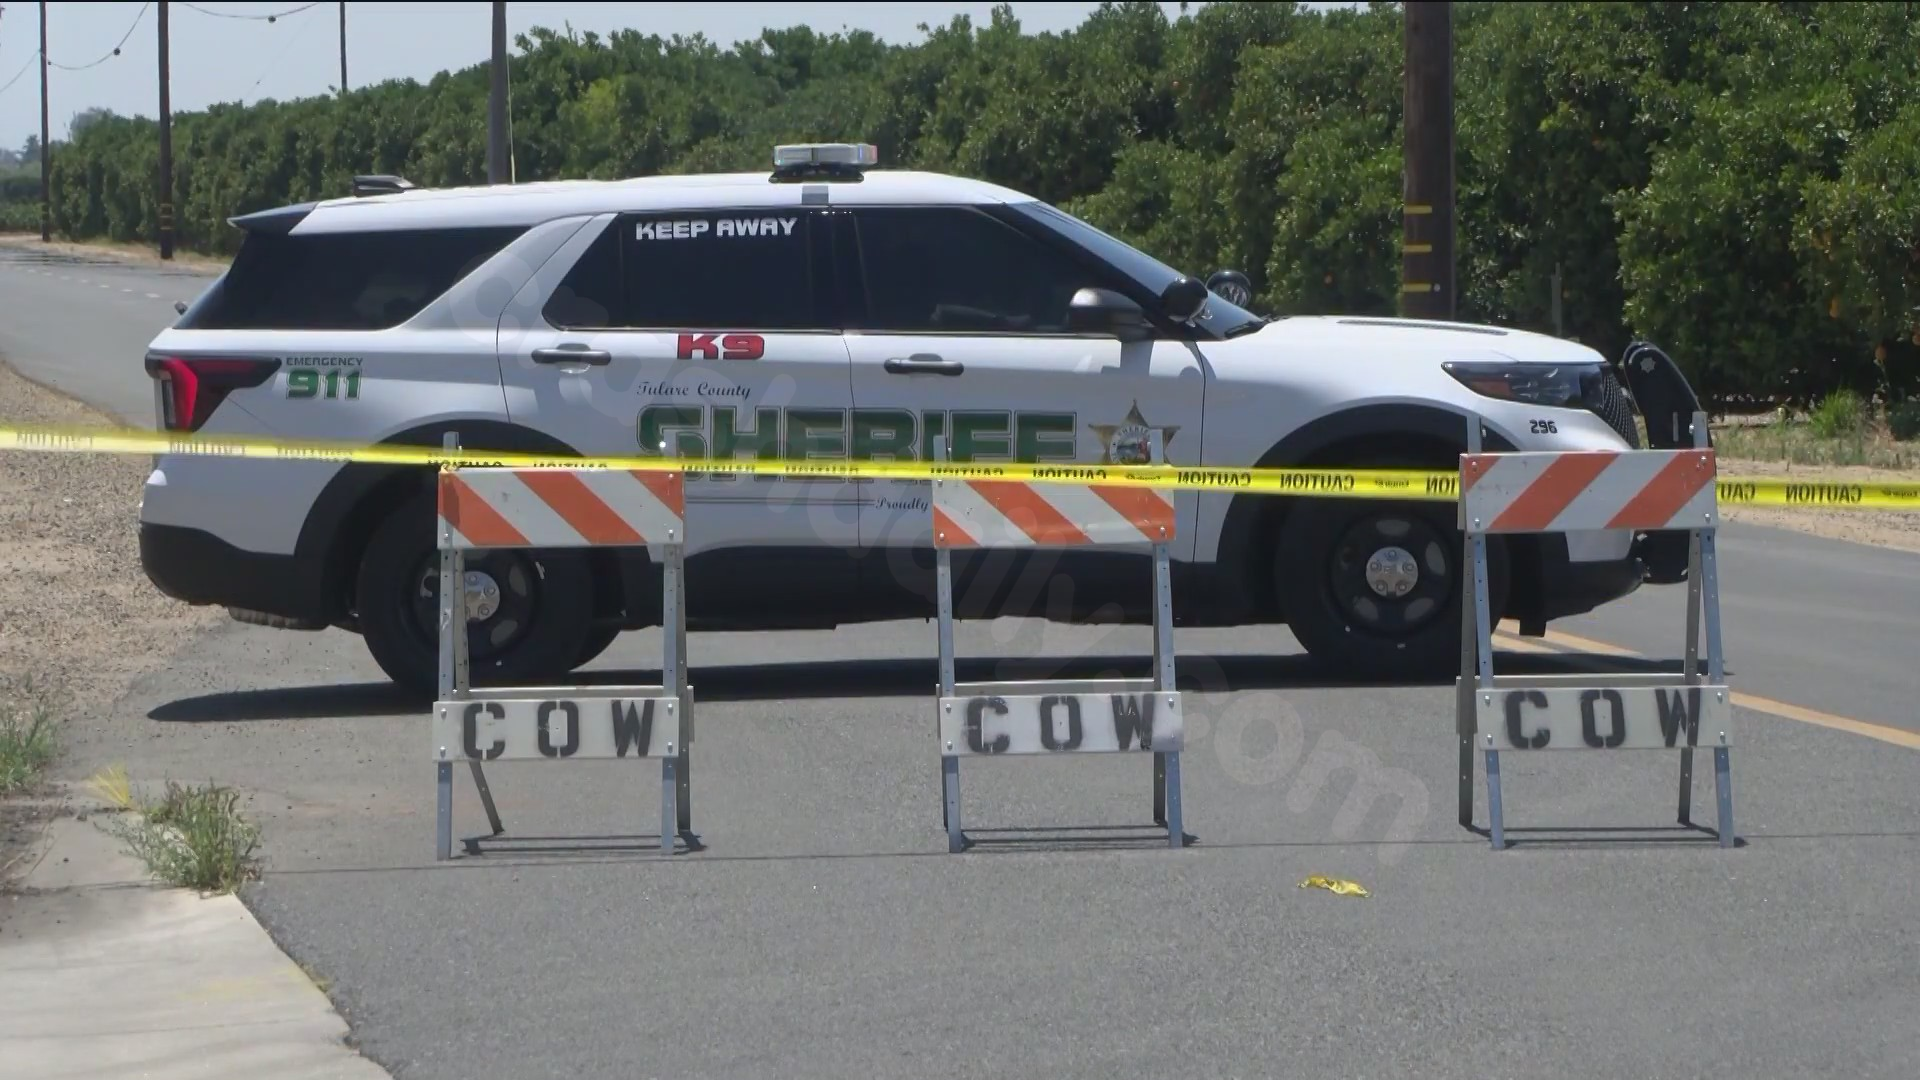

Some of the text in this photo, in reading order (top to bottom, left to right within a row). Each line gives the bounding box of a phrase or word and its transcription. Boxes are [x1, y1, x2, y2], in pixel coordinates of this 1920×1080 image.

[635, 217, 798, 240] KEEP AWAY
[677, 332, 765, 360] K9
[286, 357, 363, 366] EMERGENCY
[286, 367, 362, 400] 911
[637, 381, 751, 401] Tulare County
[1529, 419, 1558, 434] 296
[636, 404, 1078, 483] SHERIFF
[876, 496, 929, 513] Proudly
[463, 699, 655, 760] COW
[966, 693, 1155, 754] COW
[1505, 687, 1702, 749] COW
